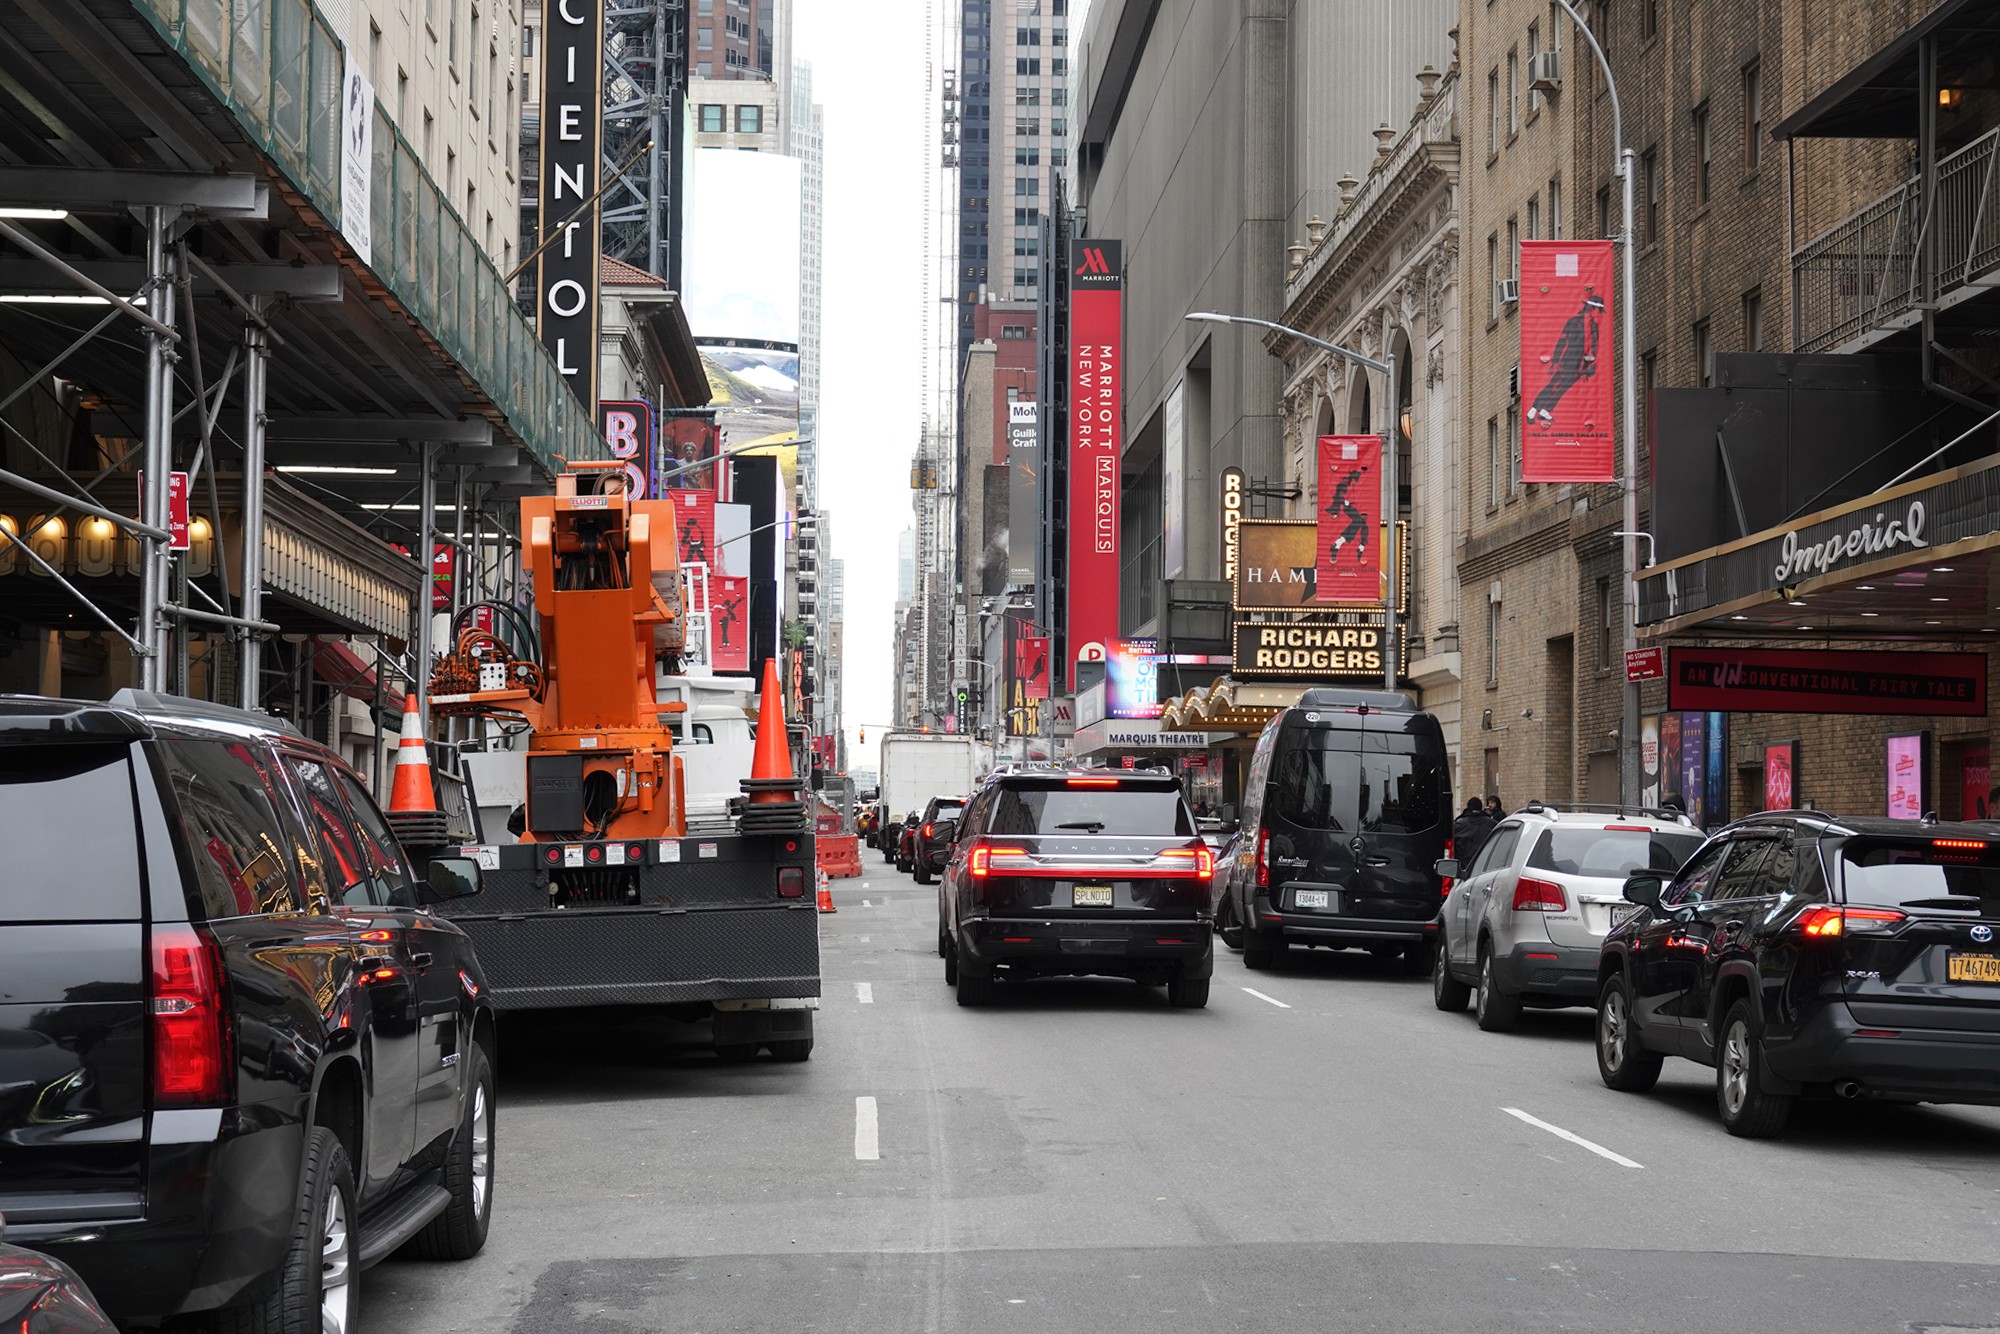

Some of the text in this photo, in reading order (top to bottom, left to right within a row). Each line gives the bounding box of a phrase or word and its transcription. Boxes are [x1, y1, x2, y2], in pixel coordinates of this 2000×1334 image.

[1082, 274, 1120, 282] MARRIOTT
[1079, 345, 1092, 448] NEW YORK
[1098, 345, 1113, 551] MARRIOTT MARQUIS
[571, 498, 601, 506] ELLIOTT
[173, 521, 185, 531] Zone
[1775, 501, 1929, 582] Imperial
[956, 617, 965, 676] MARAIS
[1260, 629, 1378, 648] RICHARD
[1256, 649, 1381, 669] RODGERS
[1628, 660, 1647, 668] Anytime
[1635, 650, 1657, 660] STANDING
[1687, 667, 1707, 683] AN
[1870, 678, 1918, 694] FAIRY
[1928, 682, 1967, 698] TALE
[1109, 734, 1204, 745] MARQUIS THEATRE
